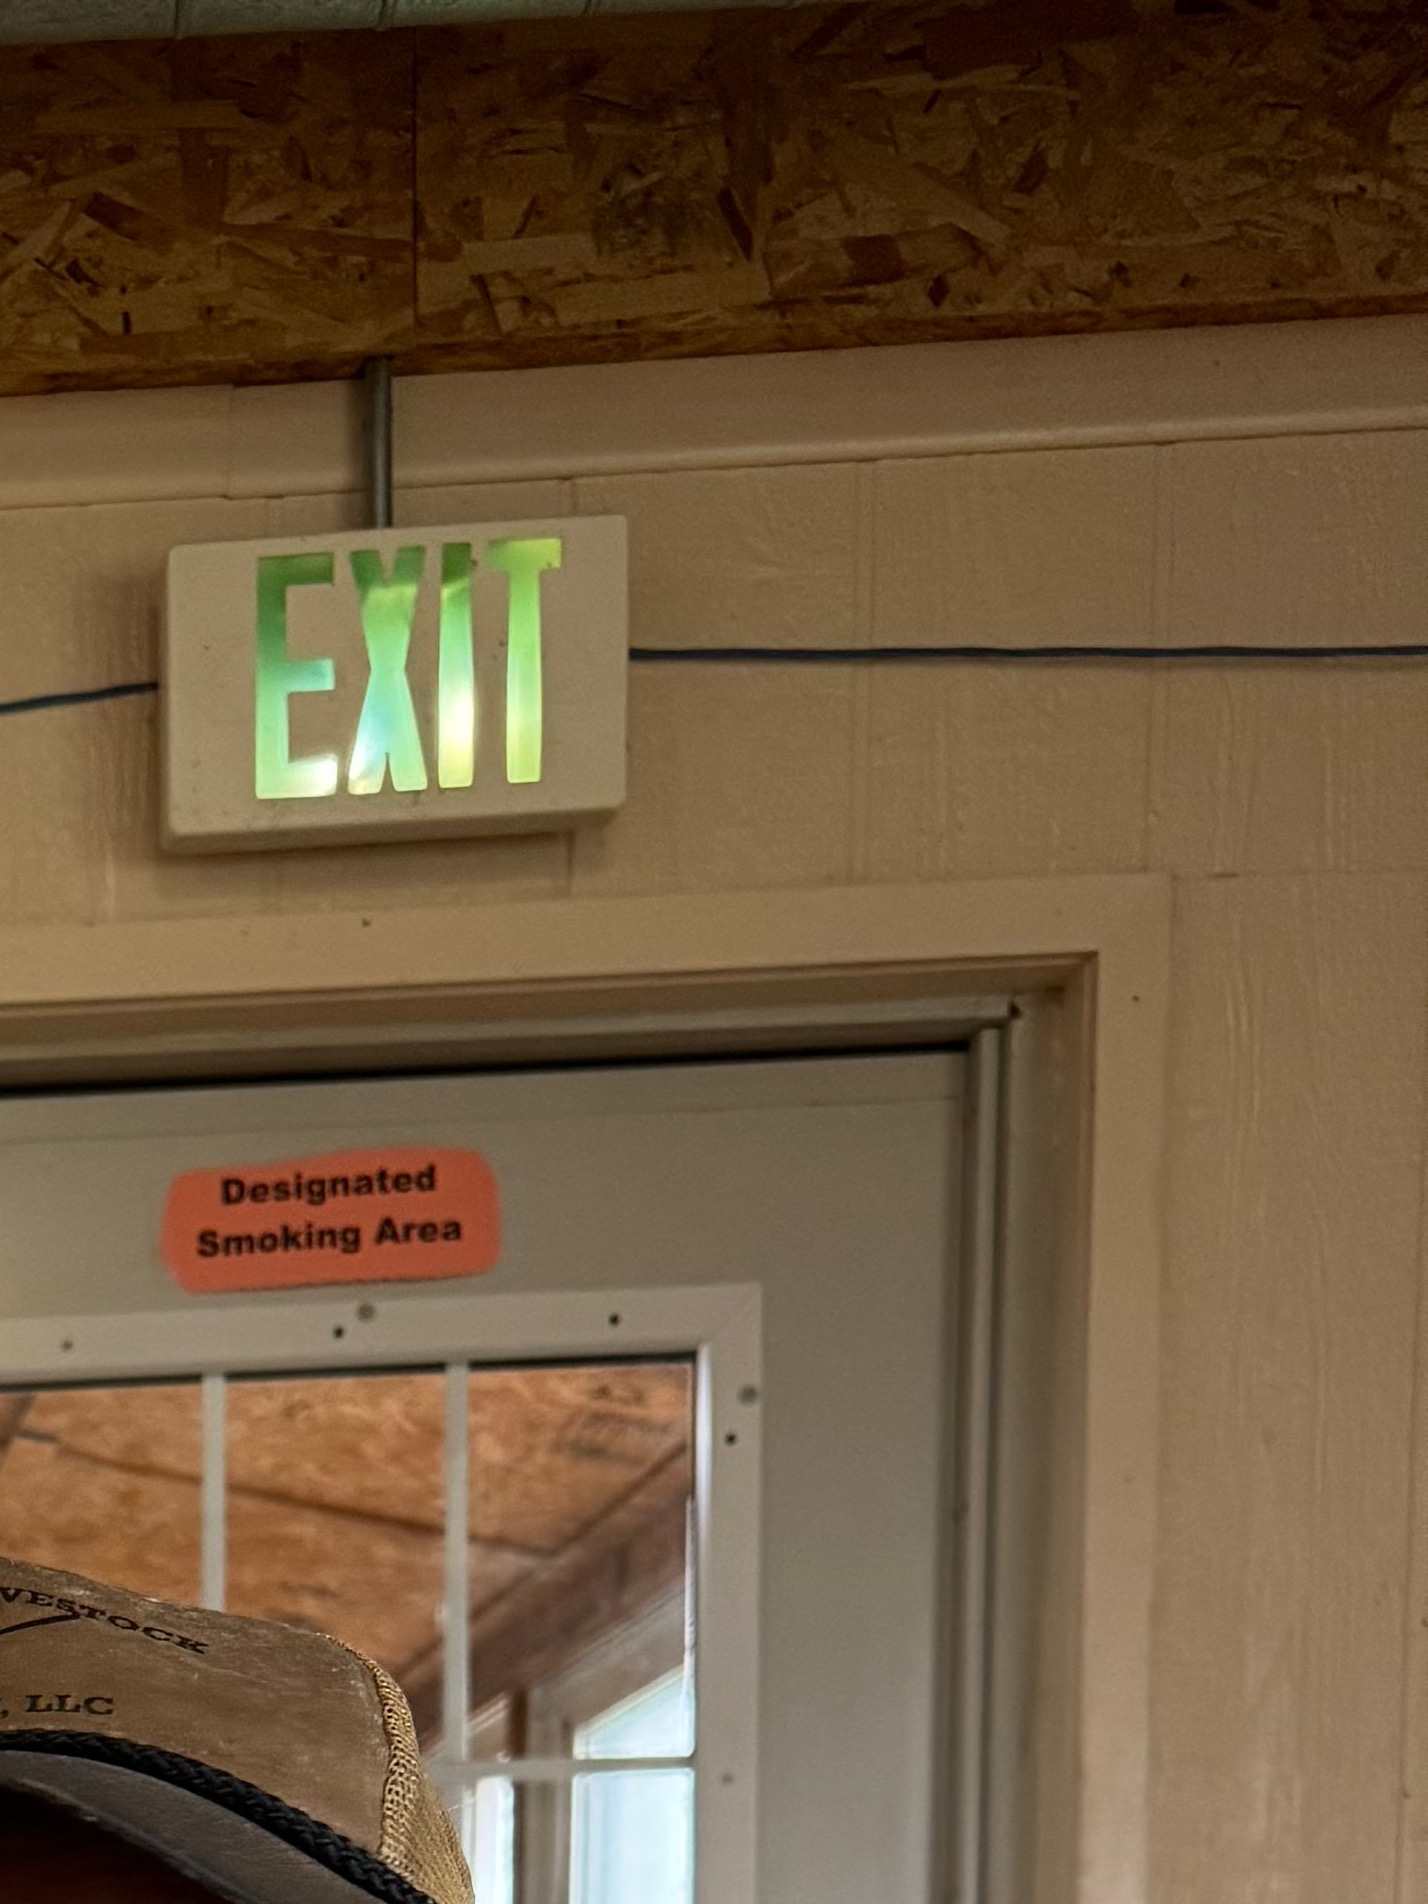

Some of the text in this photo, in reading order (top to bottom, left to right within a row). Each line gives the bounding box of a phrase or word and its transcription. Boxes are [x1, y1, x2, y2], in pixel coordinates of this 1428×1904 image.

[255, 537, 562, 800] EXIT
[220, 1163, 436, 1206] Designated
[196, 1216, 462, 1257] Smoking Area
[25, 1693, 115, 1717] LLC
